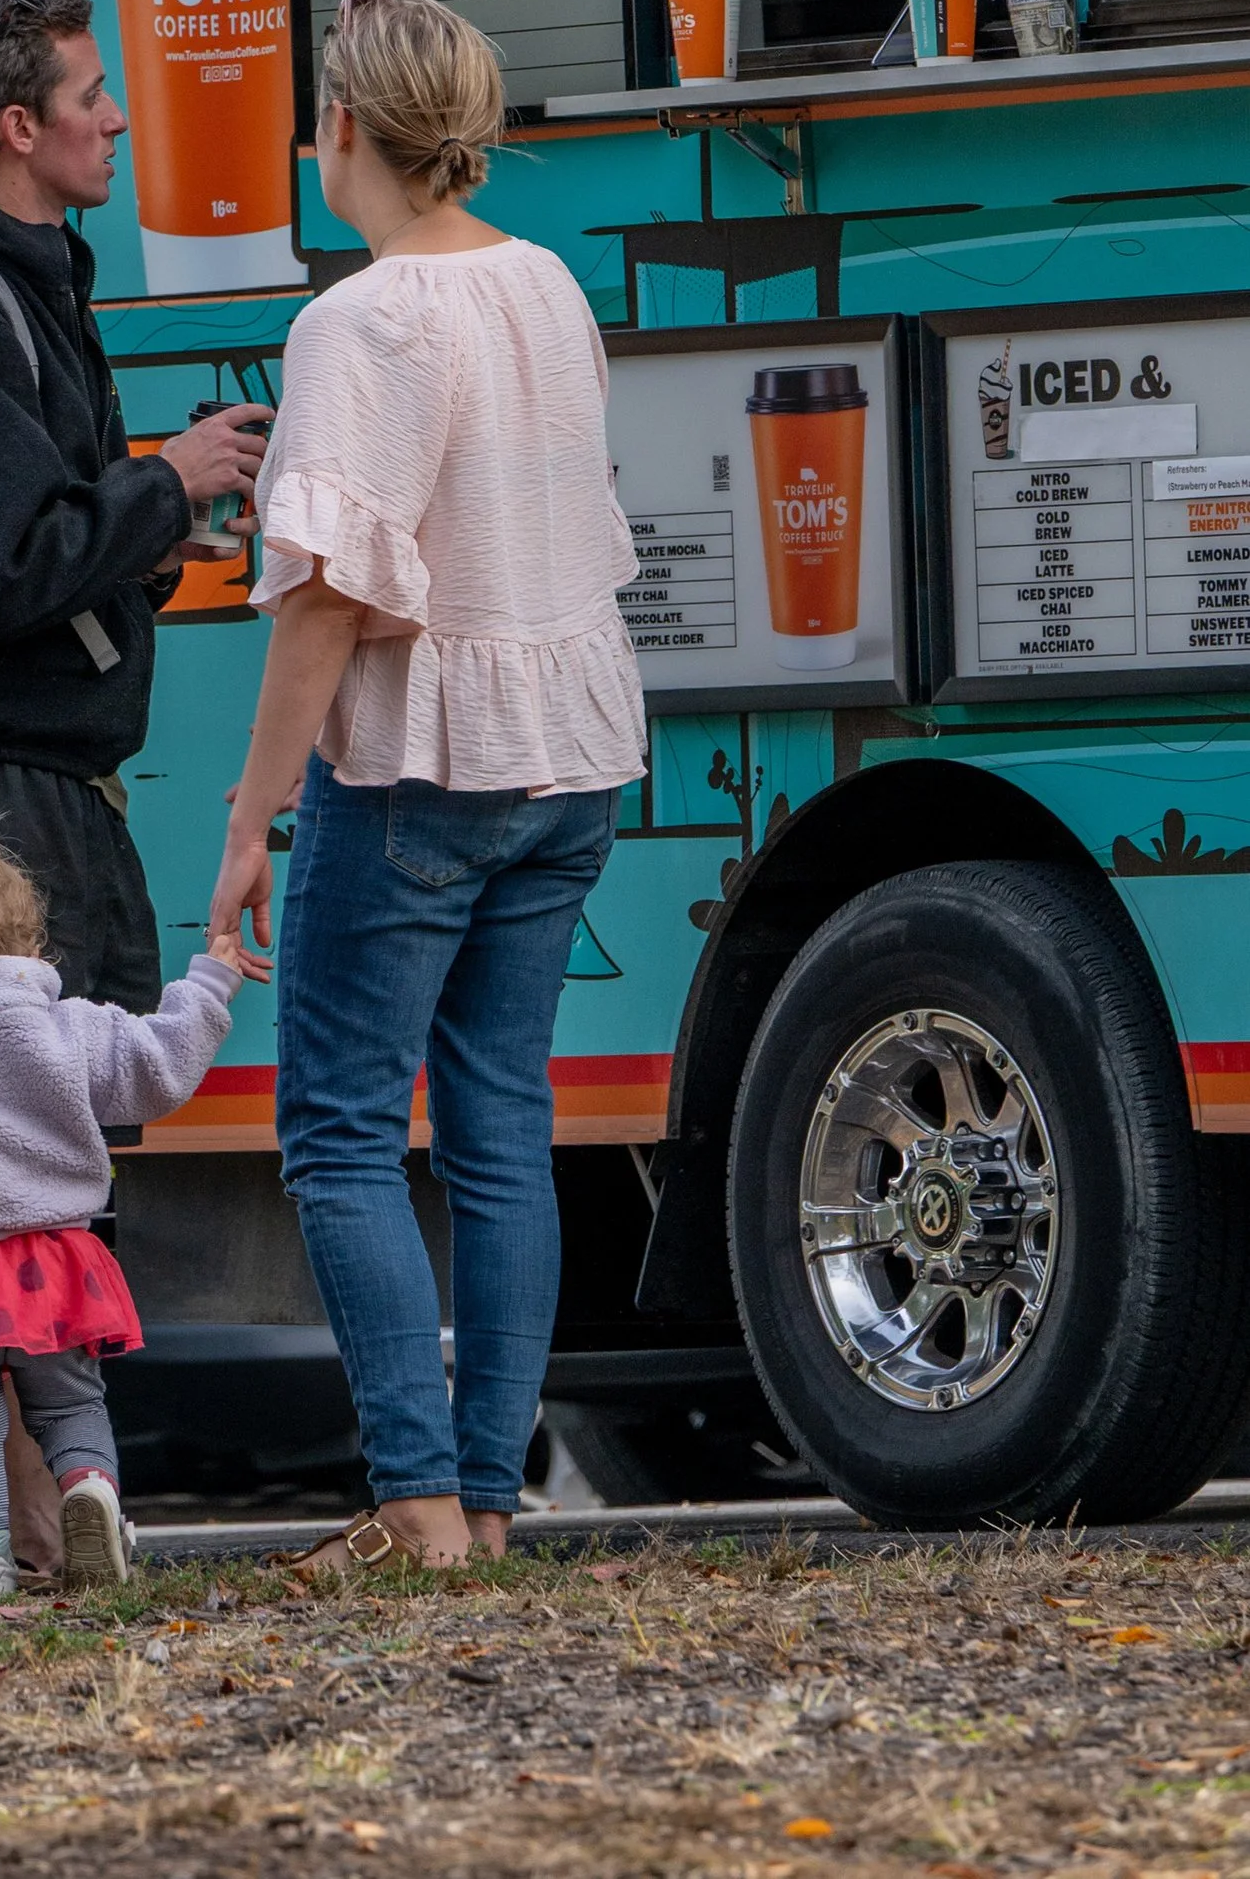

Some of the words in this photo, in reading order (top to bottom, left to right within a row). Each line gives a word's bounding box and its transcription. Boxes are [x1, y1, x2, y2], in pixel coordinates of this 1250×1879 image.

[154, 14, 220, 37] COFFEE
[228, 6, 286, 34] TRUCK
[671, 13, 696, 29] M'S
[211, 199, 238, 218] 16oz
[1019, 358, 1121, 407] ICED
[1130, 354, 1172, 400] &
[1167, 465, 1207, 475] Refreshers:
[1031, 472, 1070, 486] NITRO
[1218, 479, 1240, 490] Peach
[784, 483, 836, 496] TRAVELIN'
[1016, 490, 1049, 503] COLD
[1052, 487, 1089, 501] BREW
[773, 496, 848, 529] TOM'S
[1187, 503, 1213, 516] TILT
[1037, 511, 1070, 524] COLD
[629, 523, 656, 535] OCHA
[1189, 518, 1239, 532] ENERGY
[779, 532, 811, 544] COFFEE
[815, 529, 844, 542] TRUCK
[1035, 526, 1072, 540] BREW
[634, 546, 665, 558] OLATE
[667, 543, 706, 556] MOCHA
[1040, 549, 1069, 562] ICED
[645, 568, 672, 579] CHAI
[1035, 564, 1074, 578] LATTE
[1199, 578, 1247, 592] TOMMY
[616, 591, 641, 603] IRTY
[643, 590, 668, 601] CHAI
[1017, 588, 1046, 601] ICED
[1048, 586, 1094, 599] SPICED
[1197, 594, 1250, 608] PALMER
[1041, 602, 1071, 616] CHAI
[623, 612, 683, 625] CHOCOLATE
[1042, 625, 1071, 638] ICED
[636, 634, 670, 647] APPLE
[672, 633, 704, 645] CIDER
[1019, 639, 1095, 654] MACCHIATO
[1189, 633, 1232, 647] SWEET
